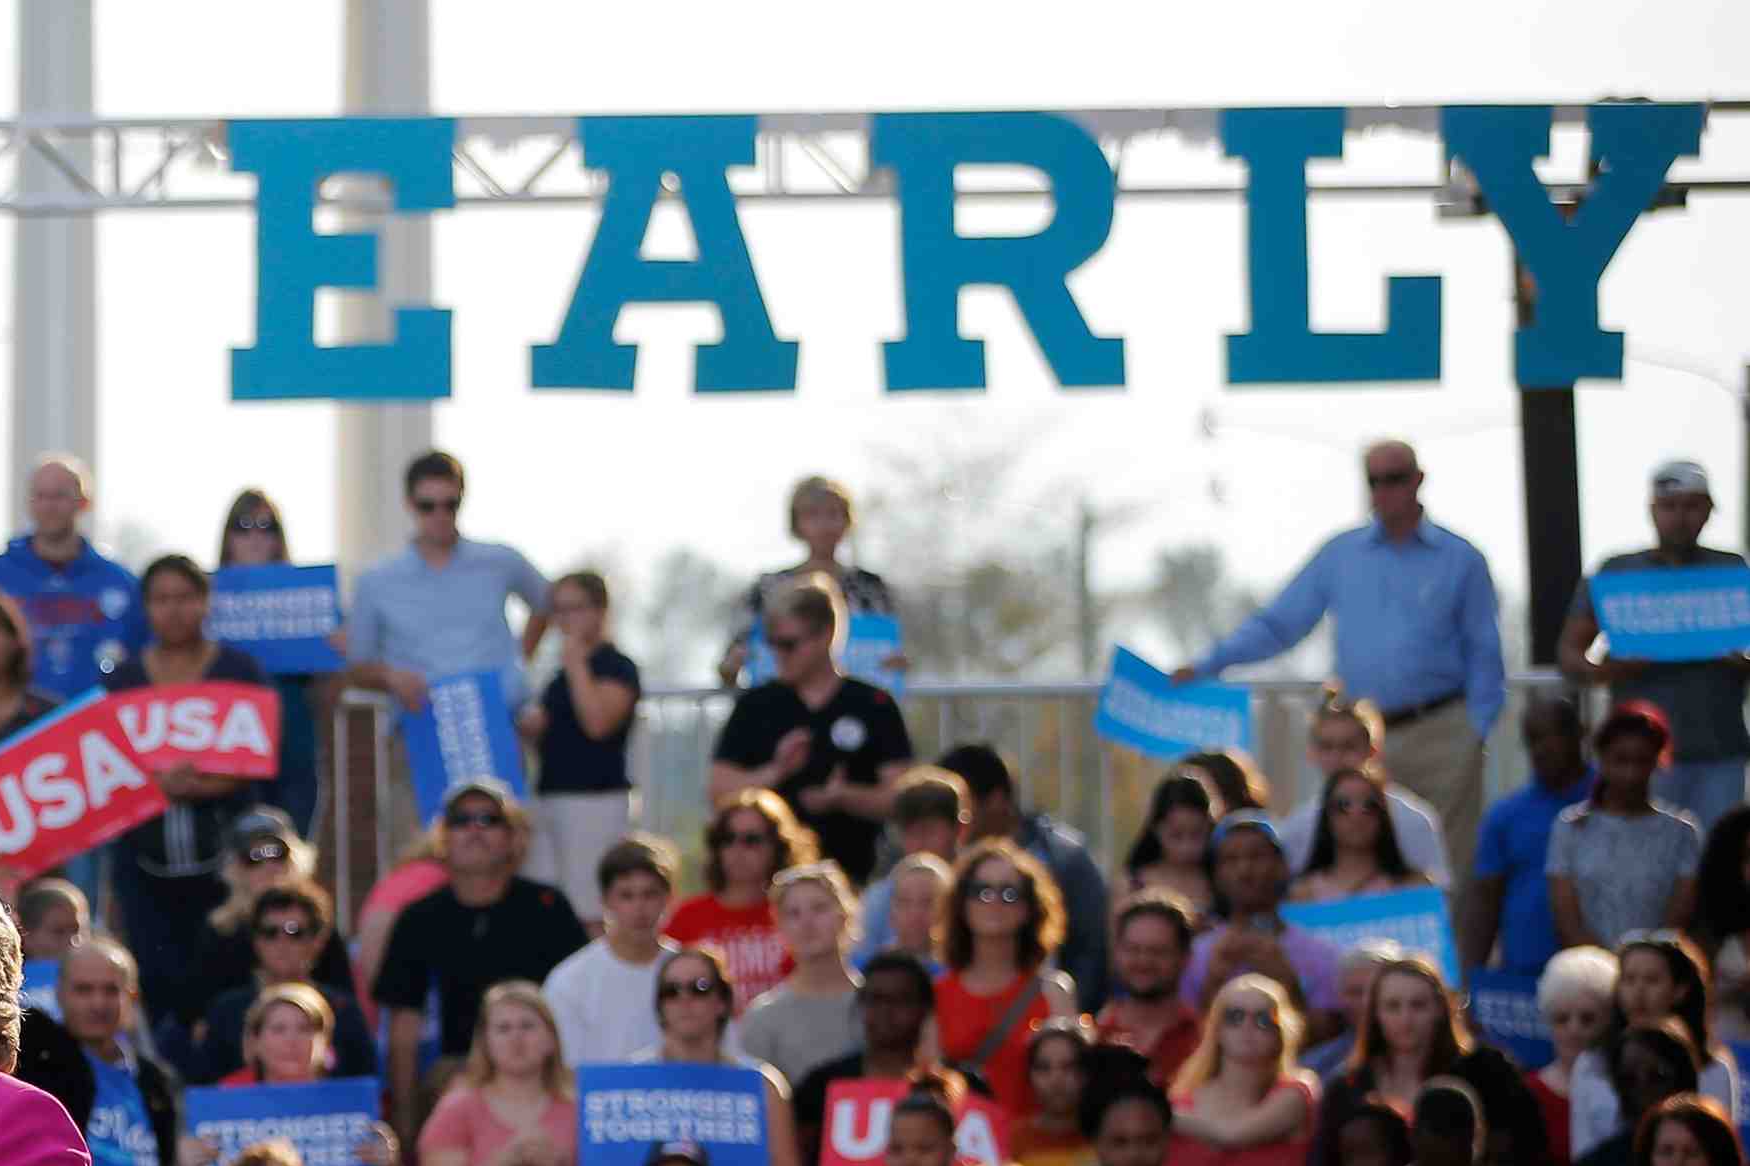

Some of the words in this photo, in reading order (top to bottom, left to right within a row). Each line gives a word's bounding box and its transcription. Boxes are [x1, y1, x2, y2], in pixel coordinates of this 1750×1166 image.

[227, 102, 1706, 404] EARLY
[117, 697, 272, 757] USA
[585, 1088, 759, 1121] STRONGER
[587, 1118, 762, 1145] TOGETHER
